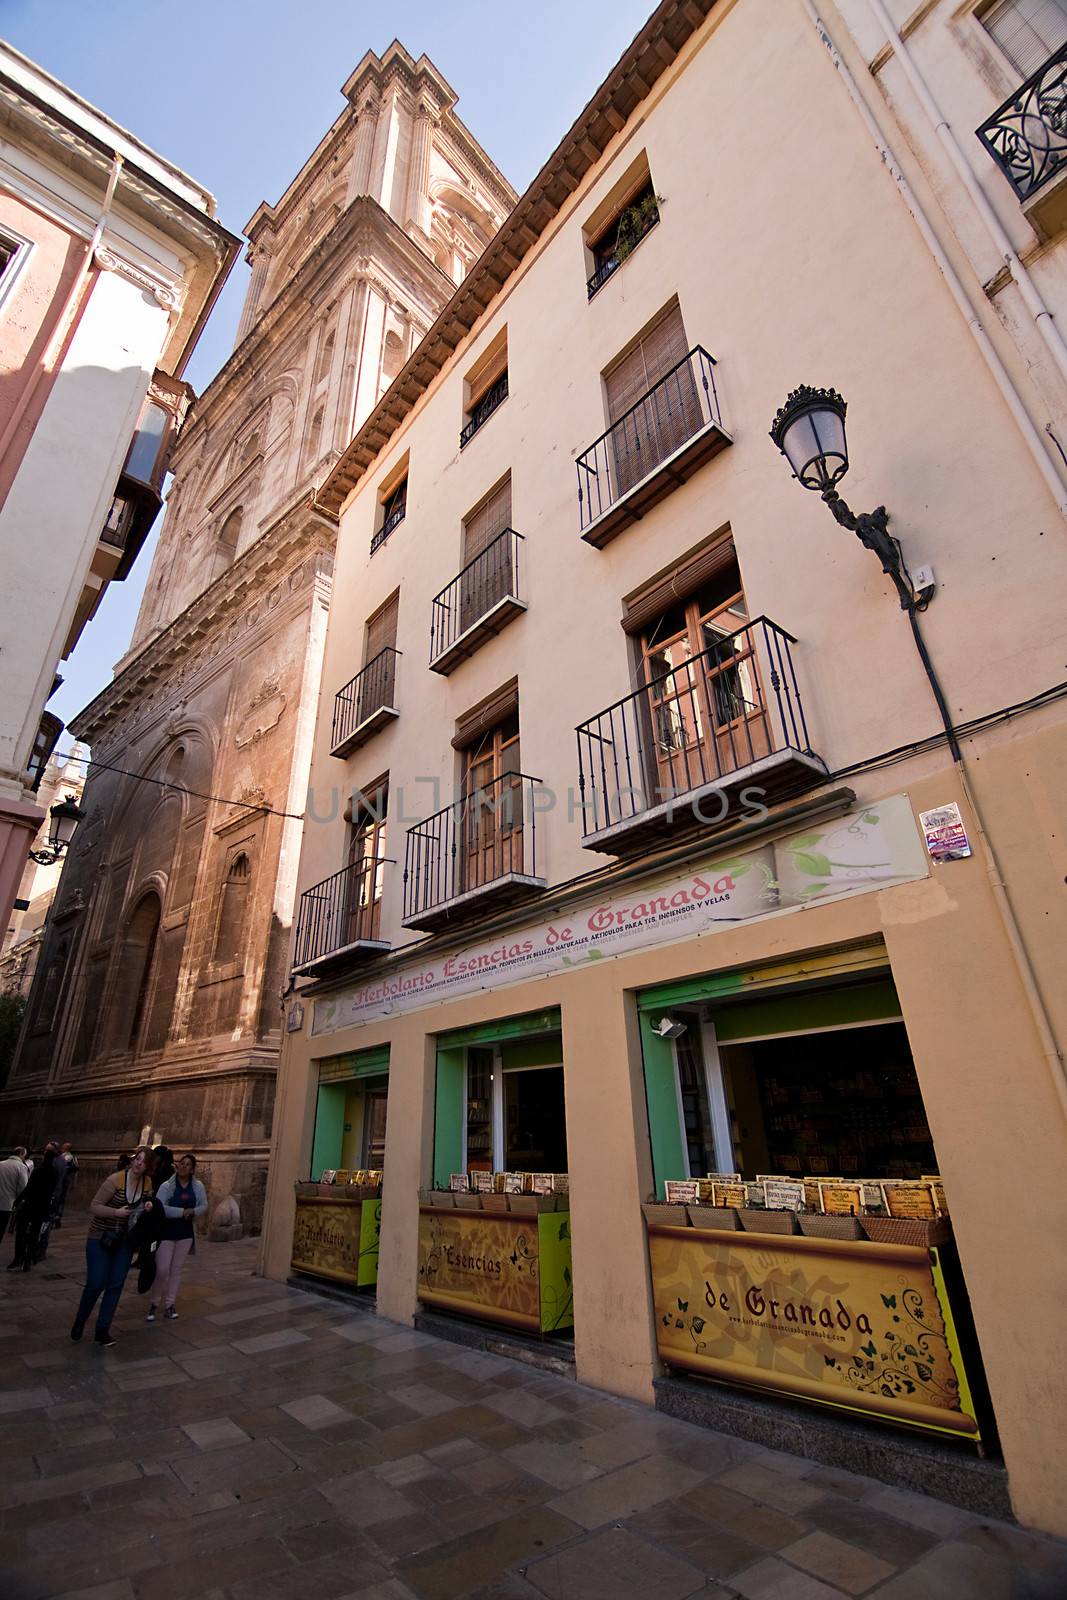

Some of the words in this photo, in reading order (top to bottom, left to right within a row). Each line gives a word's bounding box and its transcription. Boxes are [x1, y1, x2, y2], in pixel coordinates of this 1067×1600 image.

[353, 972, 434, 1006] Herbolario
[443, 941, 533, 977] Esencias
[545, 926, 573, 945] de
[587, 875, 736, 932] Granada
[533, 947, 554, 958] BELLEZA
[625, 919, 642, 931] PARA
[658, 904, 695, 920] INCIENSOS
[697, 901, 703, 909] Y
[704, 893, 730, 906] VELAS
[443, 1245, 501, 1273] Esencias
[705, 1281, 730, 1312] de
[745, 1285, 873, 1335] Granada
